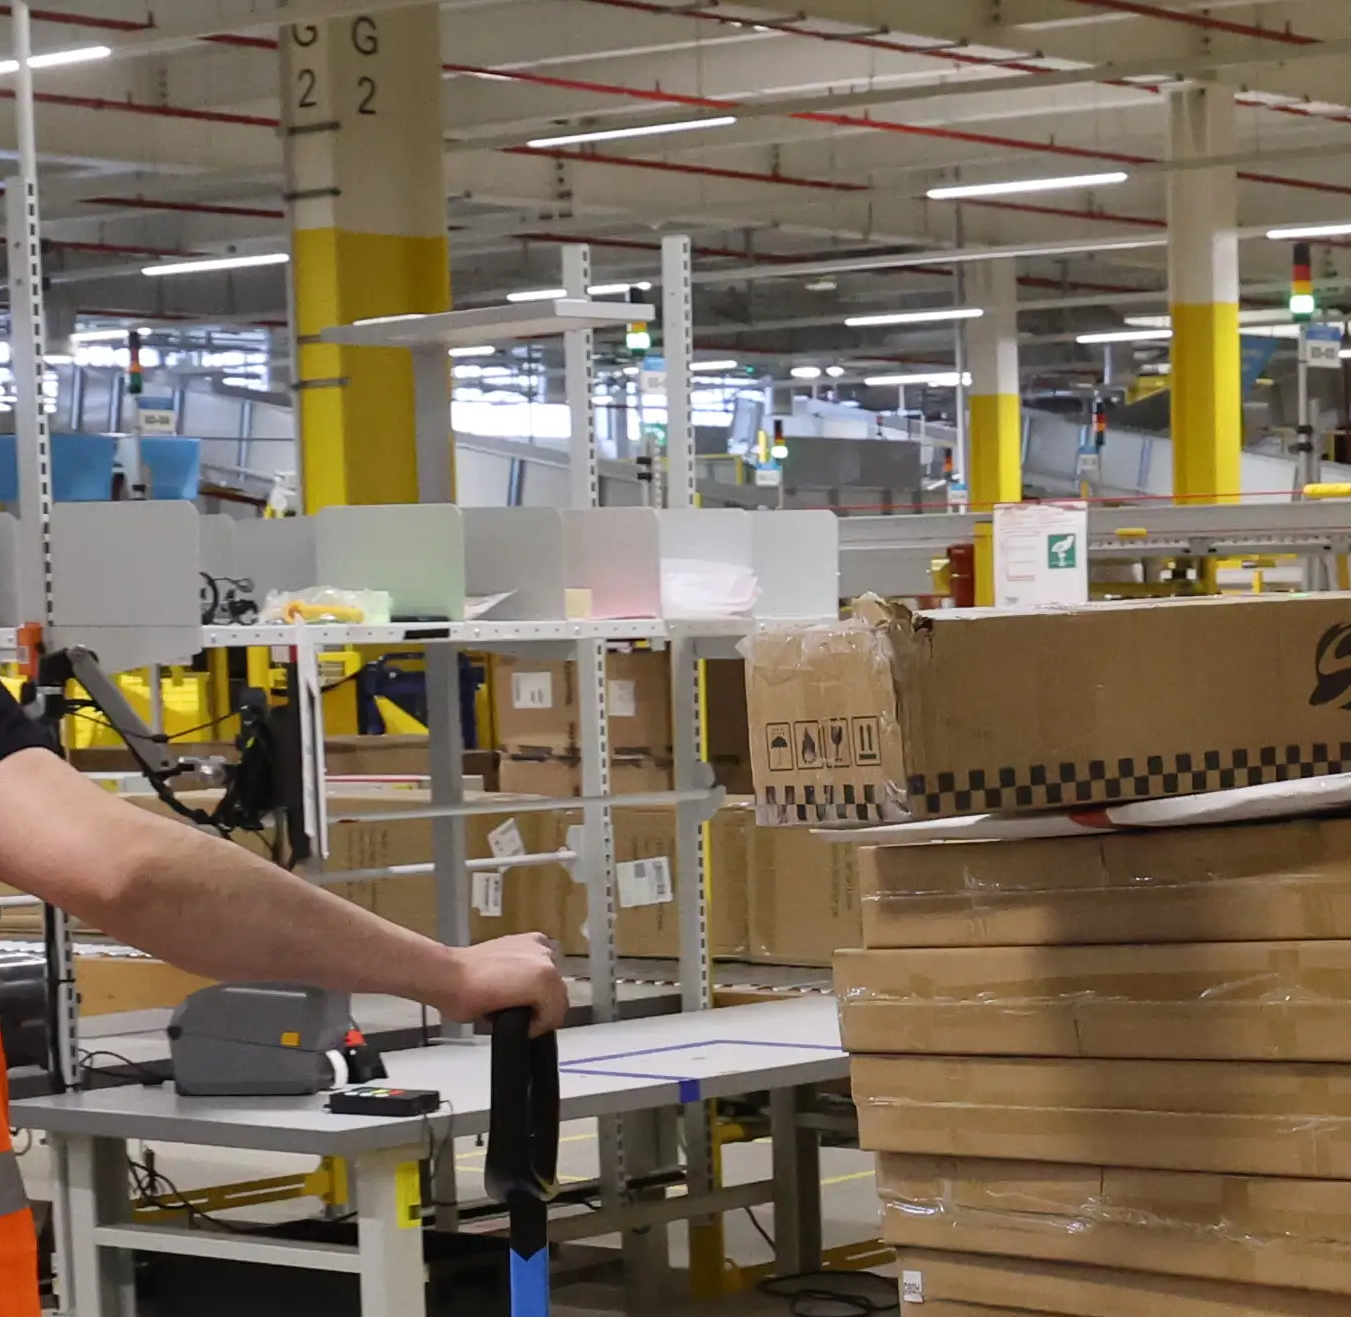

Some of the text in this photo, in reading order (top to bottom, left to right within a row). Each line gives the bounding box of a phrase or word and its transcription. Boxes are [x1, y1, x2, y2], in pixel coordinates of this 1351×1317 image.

[352, 16, 378, 56] G
[298, 68, 317, 108] 2
[357, 76, 377, 115] 2
